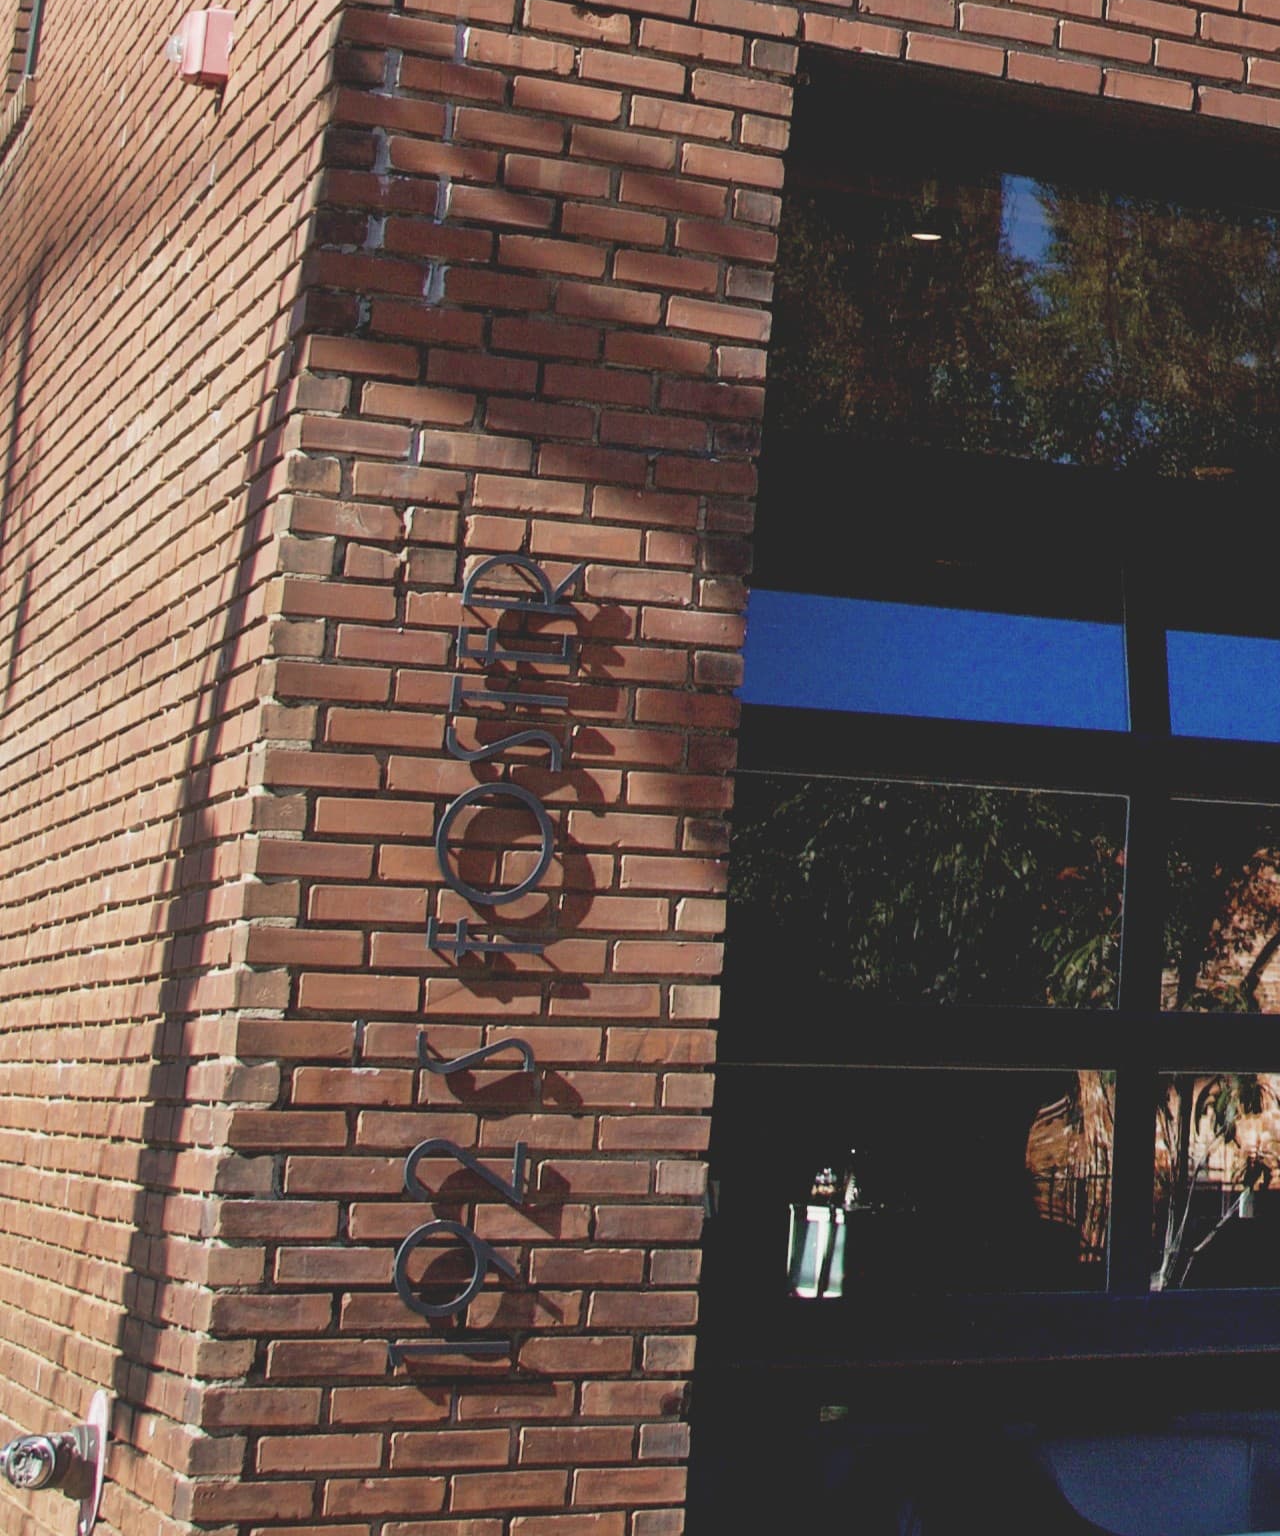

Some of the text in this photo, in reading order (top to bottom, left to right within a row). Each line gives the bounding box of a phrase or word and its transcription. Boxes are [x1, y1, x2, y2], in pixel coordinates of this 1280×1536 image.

[388, 553, 585, 1366] 192 S FOSTER
